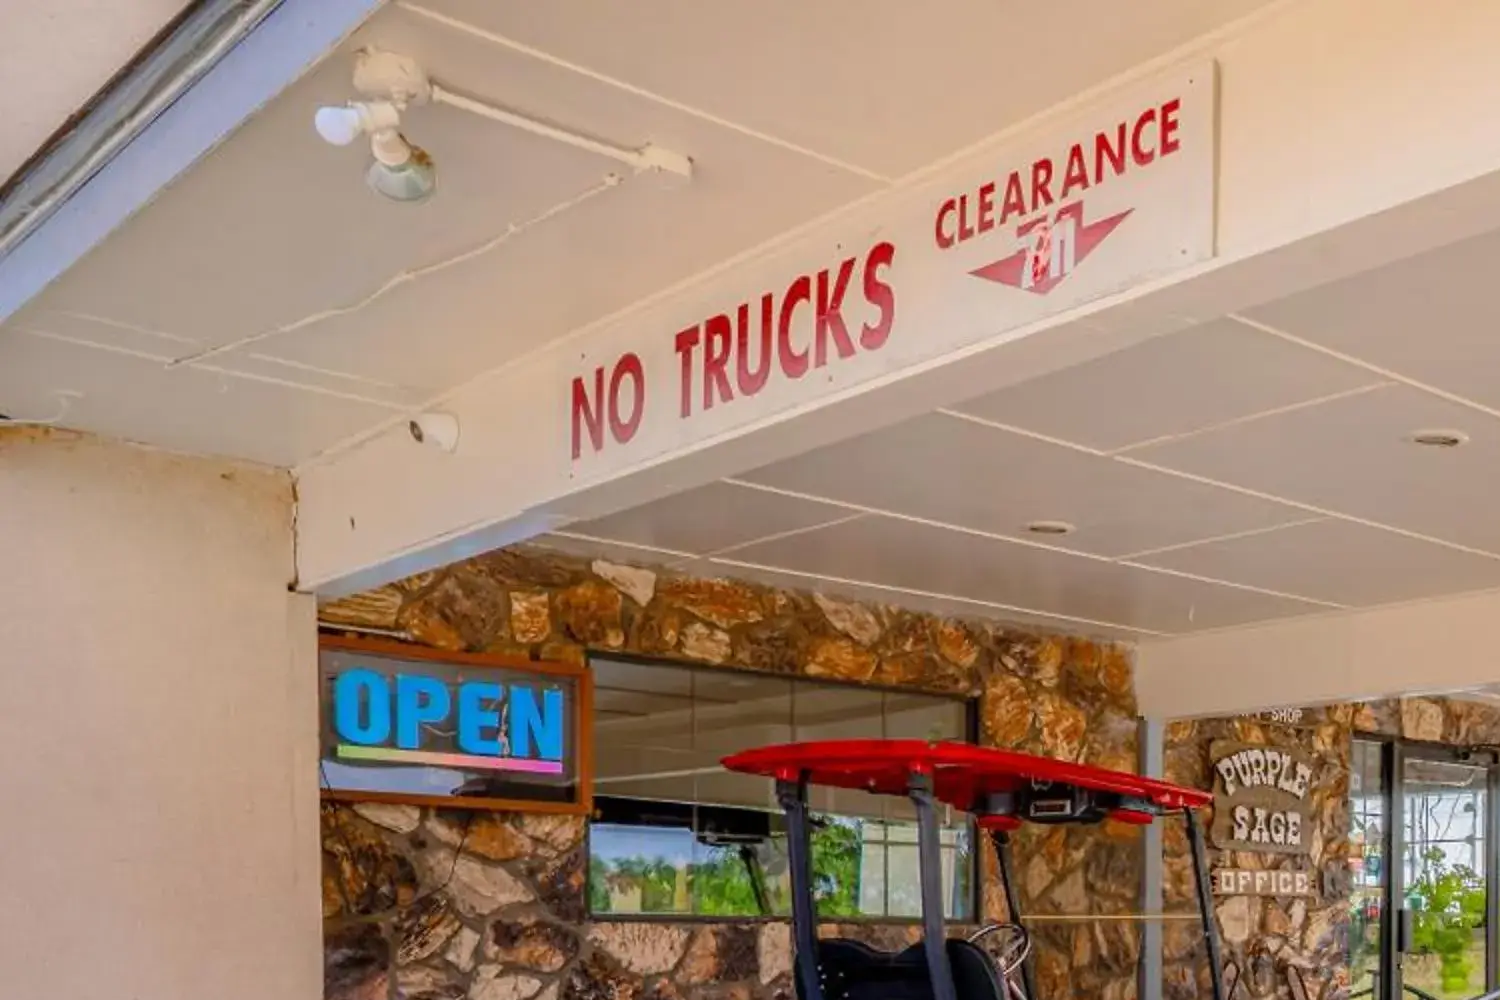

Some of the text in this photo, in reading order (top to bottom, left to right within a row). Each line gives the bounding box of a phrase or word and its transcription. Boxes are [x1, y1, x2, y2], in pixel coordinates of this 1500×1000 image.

[934, 97, 1181, 250] CLEARANCE
[571, 241, 896, 461] NO TRUCKS
[333, 667, 564, 760] OPEN
[1271, 708, 1303, 724] SHOP
[1217, 749, 1313, 800] PURPLE
[1233, 805, 1301, 846] SAGE
[1220, 870, 1309, 894] OFFICE
